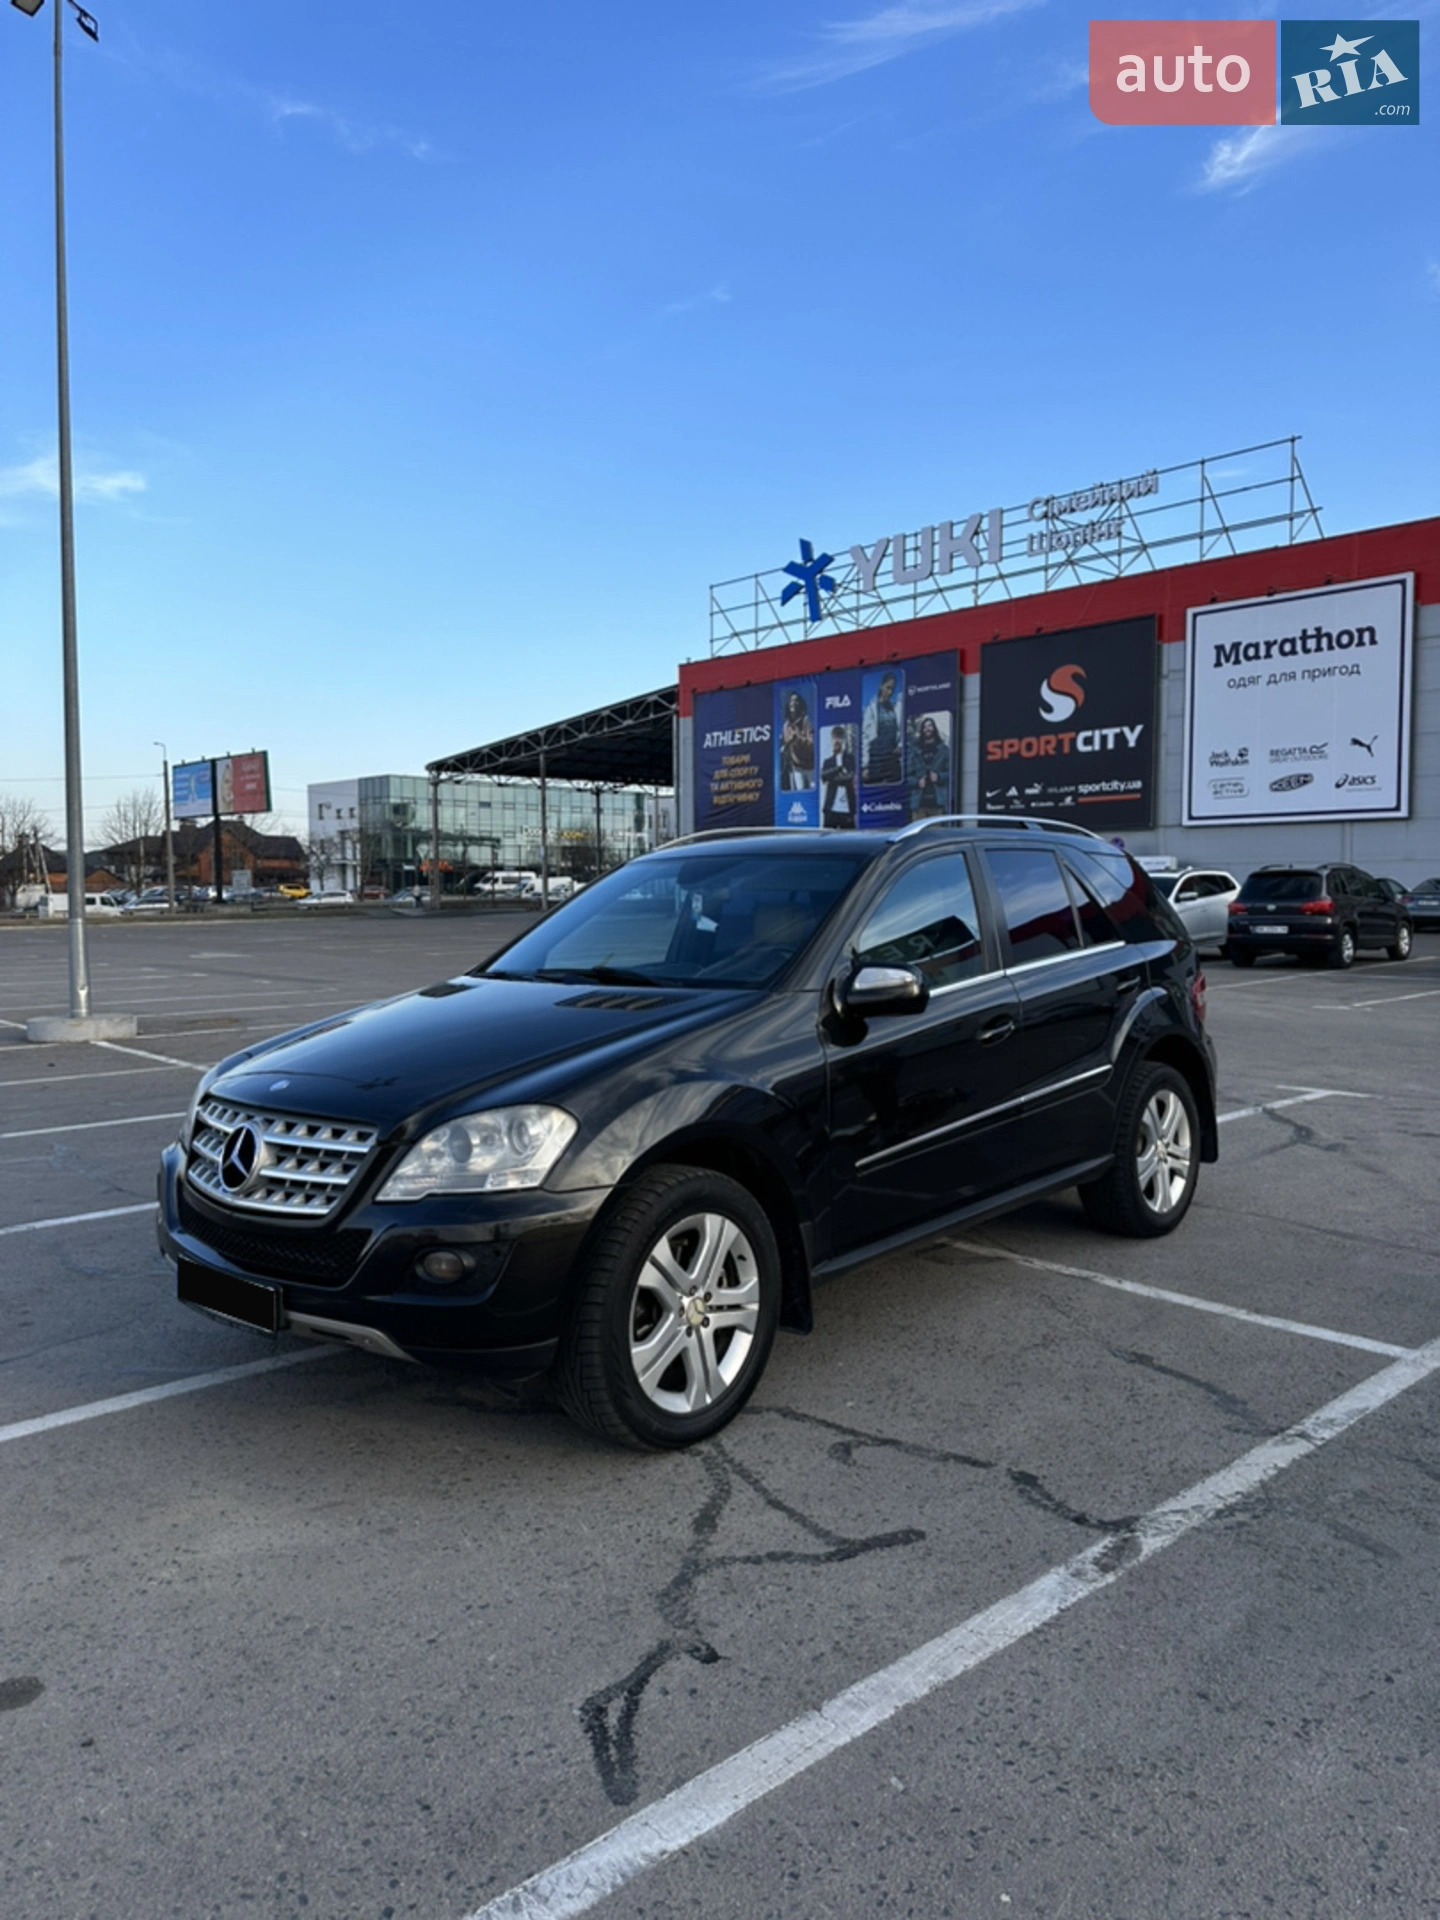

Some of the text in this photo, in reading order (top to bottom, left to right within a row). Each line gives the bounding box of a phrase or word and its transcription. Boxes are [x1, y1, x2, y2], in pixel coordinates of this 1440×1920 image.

[1026, 469, 1160, 521] Сімейний
[850, 507, 1004, 592] YUKI
[1213, 625, 1378, 668] Marathon
[1227, 663, 1361, 690] одяг для пригод
[825, 694, 851, 709] FILA
[703, 725, 771, 748] ATHLETICS
[986, 724, 1144, 761] SPORTCITY
[1078, 780, 1142, 794] sportcity.ua
